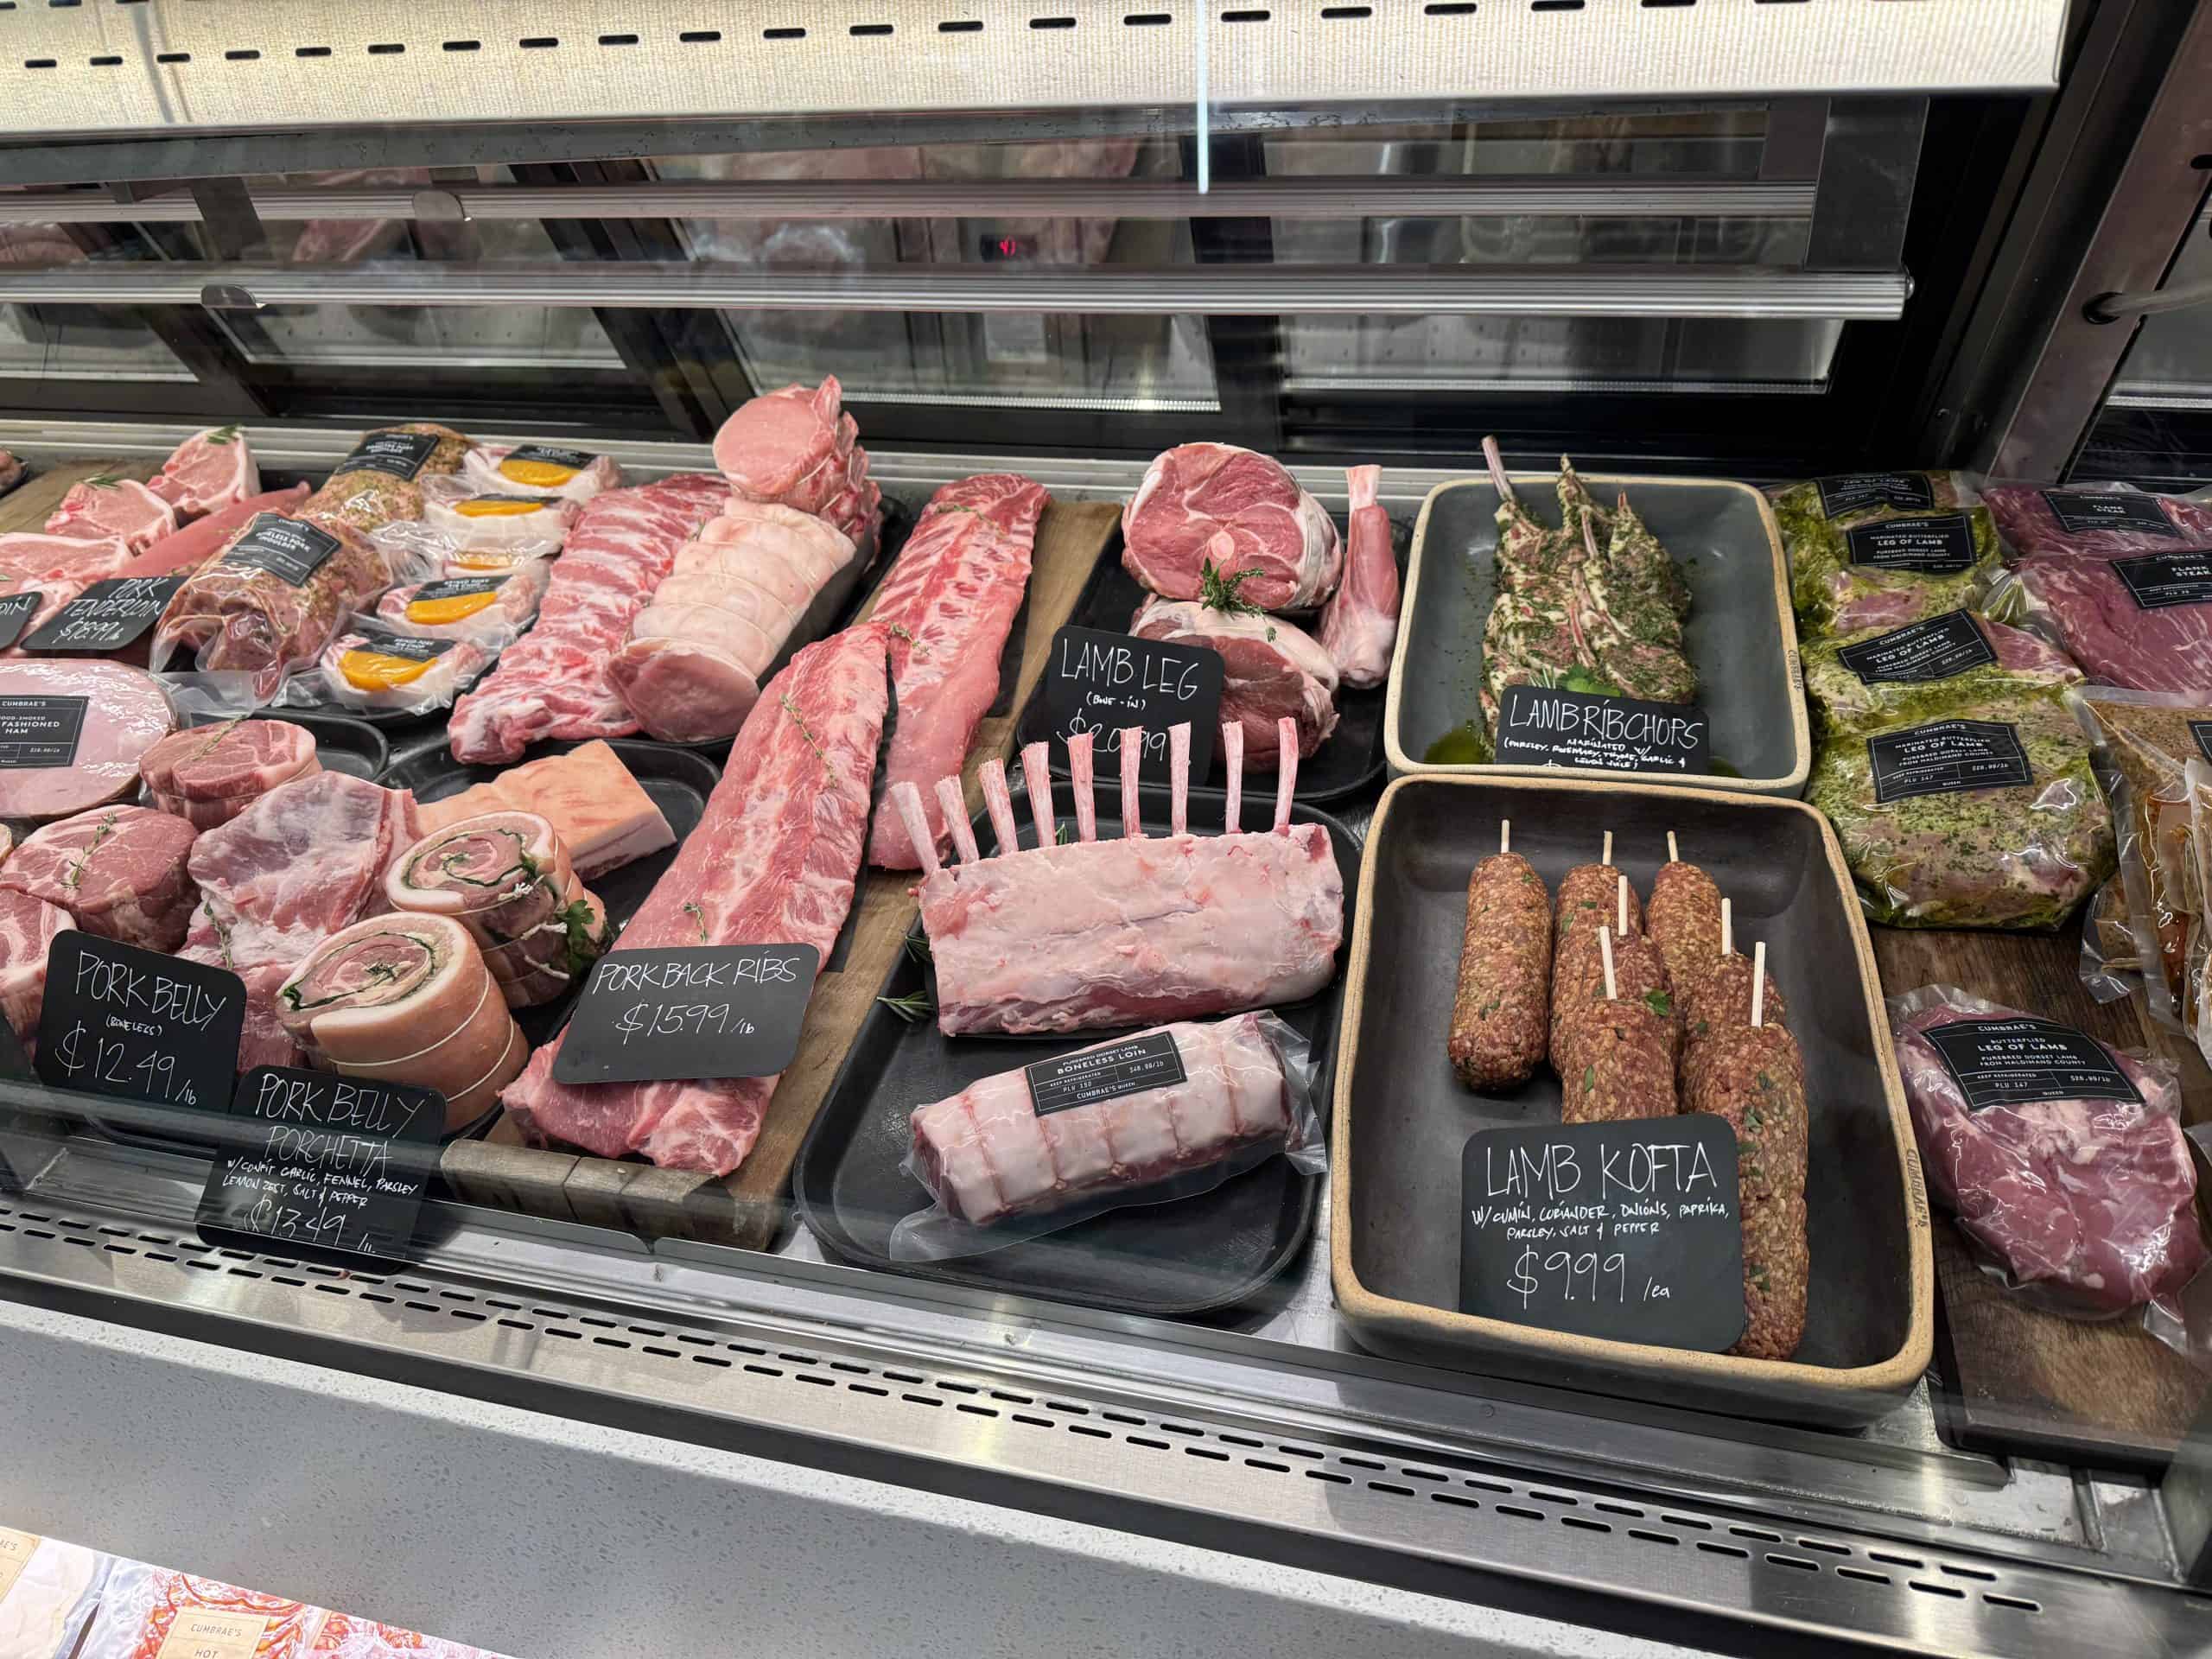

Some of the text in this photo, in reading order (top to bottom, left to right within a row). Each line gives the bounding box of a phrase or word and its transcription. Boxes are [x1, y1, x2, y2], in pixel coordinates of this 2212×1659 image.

[108, 576, 169, 599] PORK
[1876, 634, 1946, 664] LEG OF LAMB
[1061, 638, 1199, 701] LAMB LEG
[1056, 707, 1166, 761] $2099
[1509, 694, 1580, 732] LAMB
[1624, 711, 1704, 750] CHOPS
[1914, 723, 1967, 735] CUMBRAE'S
[1904, 744, 1927, 753] LEG
[593, 950, 801, 995] PORK BACK RIBS
[76, 950, 227, 1031] PORK BELLY
[1977, 1023, 2037, 1032] CUMBRAE'S
[54, 1020, 175, 1099] $12.49
[1057, 1048, 1147, 1075] BONELESS LOIN
[256, 1072, 426, 1139] PORK BELLY
[1077, 1085, 1117, 1100] CUMBRAE'S
[264, 1124, 396, 1178] PORCHETTA
[376, 1177, 419, 1196] PARSLEY
[1487, 1141, 1719, 1200] LAMB KOFTA
[222, 1174, 258, 1190] LEMON
[292, 1184, 318, 1200] SALT
[328, 1190, 369, 1210] PEPPER
[1560, 1224, 1590, 1238] SALT
[1614, 1222, 1661, 1236] PEPPER
[1506, 1244, 1624, 1310] $9.99
[191, 1624, 243, 1637] CUMBRAE'S
[194, 1649, 220, 1659] HOT
